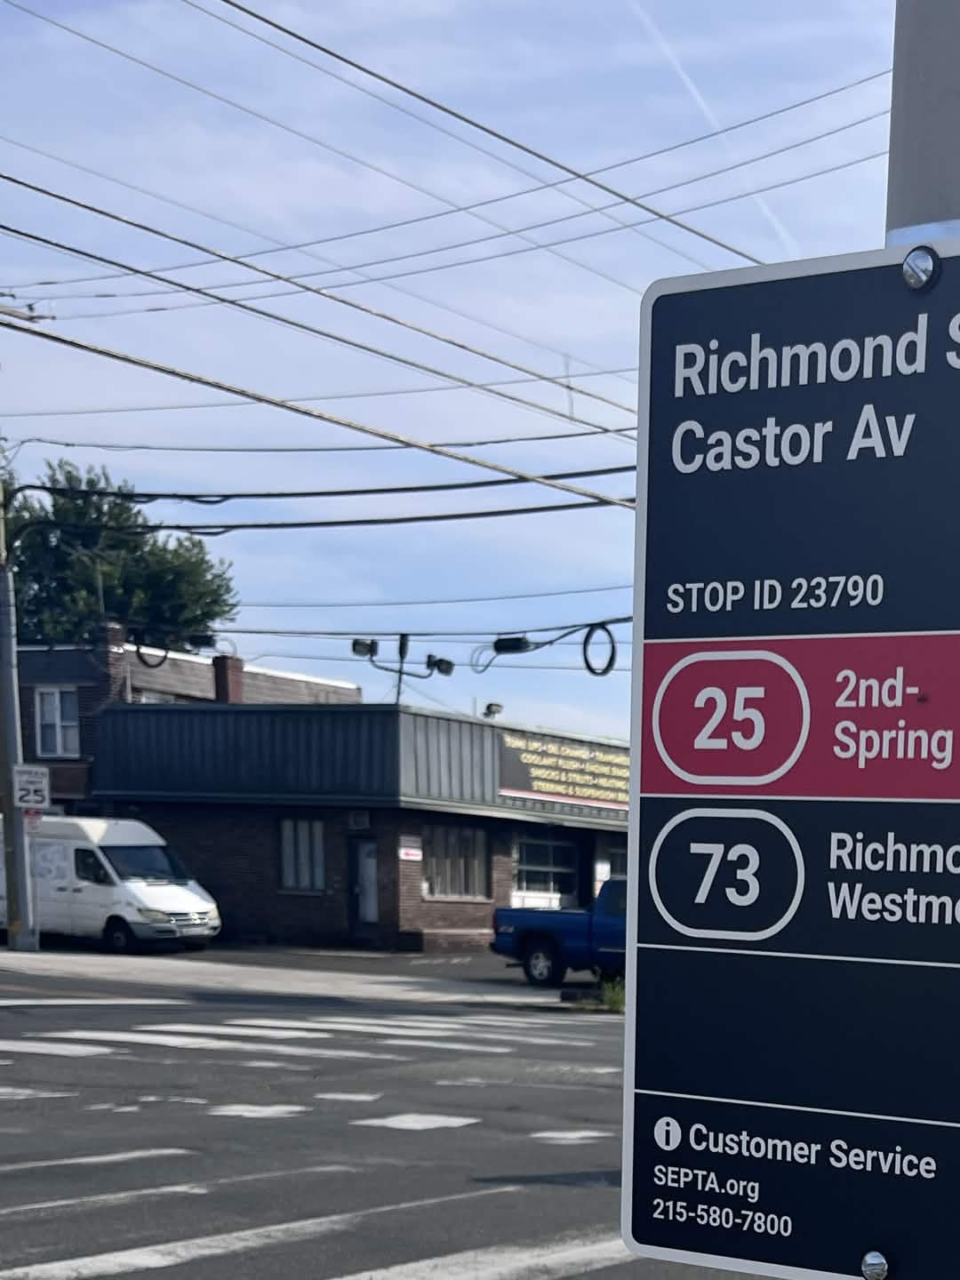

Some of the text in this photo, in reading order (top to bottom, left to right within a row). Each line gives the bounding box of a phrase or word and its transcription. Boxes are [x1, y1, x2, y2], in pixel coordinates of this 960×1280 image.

[674, 313, 928, 397] Richmond
[671, 404, 916, 473] Castor Av
[666, 574, 884, 613] STOP ID 23790
[835, 666, 920, 707] 2nd-
[693, 686, 766, 750] 25
[833, 719, 953, 770] Spring
[19, 788, 46, 804] 25
[689, 842, 761, 906] 73
[689, 1123, 937, 1179] Customer Service
[653, 1164, 759, 1203] SEPTA.org
[652, 1198, 792, 1238] 215-580-7800
